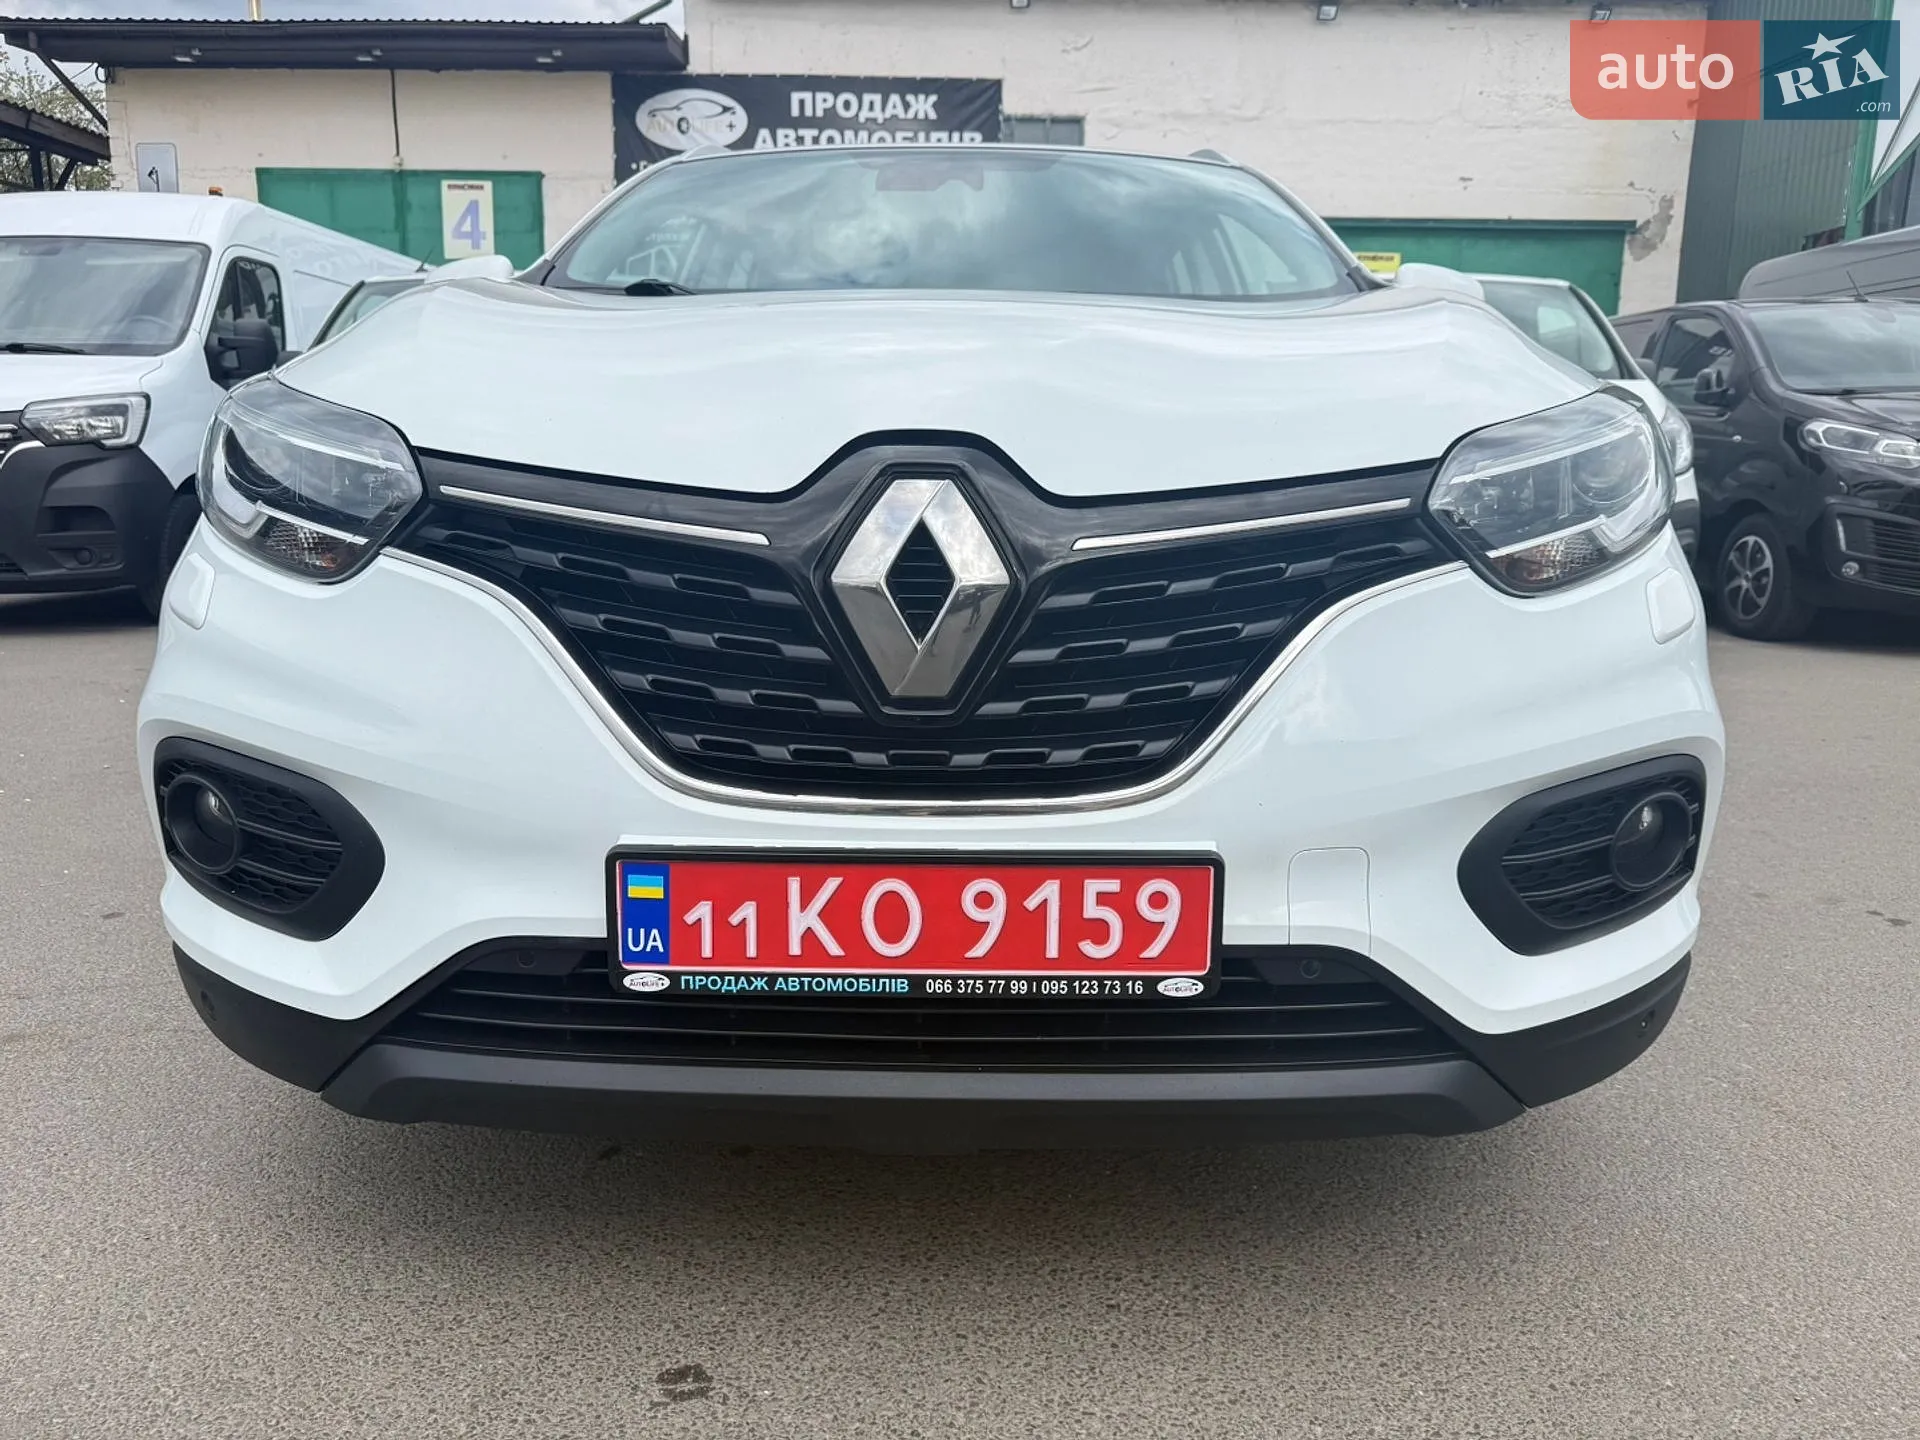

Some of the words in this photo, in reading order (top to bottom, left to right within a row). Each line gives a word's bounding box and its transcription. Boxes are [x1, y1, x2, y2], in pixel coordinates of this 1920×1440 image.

[789, 90, 939, 124] ПРОДАЖ
[451, 199, 487, 250] 4
[682, 900, 758, 959] 11
[961, 878, 1182, 959] 9159
[627, 927, 664, 953] UA
[680, 975, 769, 993] ПРОДАЖ
[774, 976, 909, 993] АВТОМОБІЛІВ
[925, 978, 953, 994] 066
[957, 979, 984, 994] 375
[988, 979, 1006, 995] 77
[1010, 979, 1028, 995] 99
[1041, 980, 1068, 995] 095
[1072, 980, 1099, 995] 123
[1103, 980, 1121, 995] 73
[1126, 980, 1144, 995] 16
